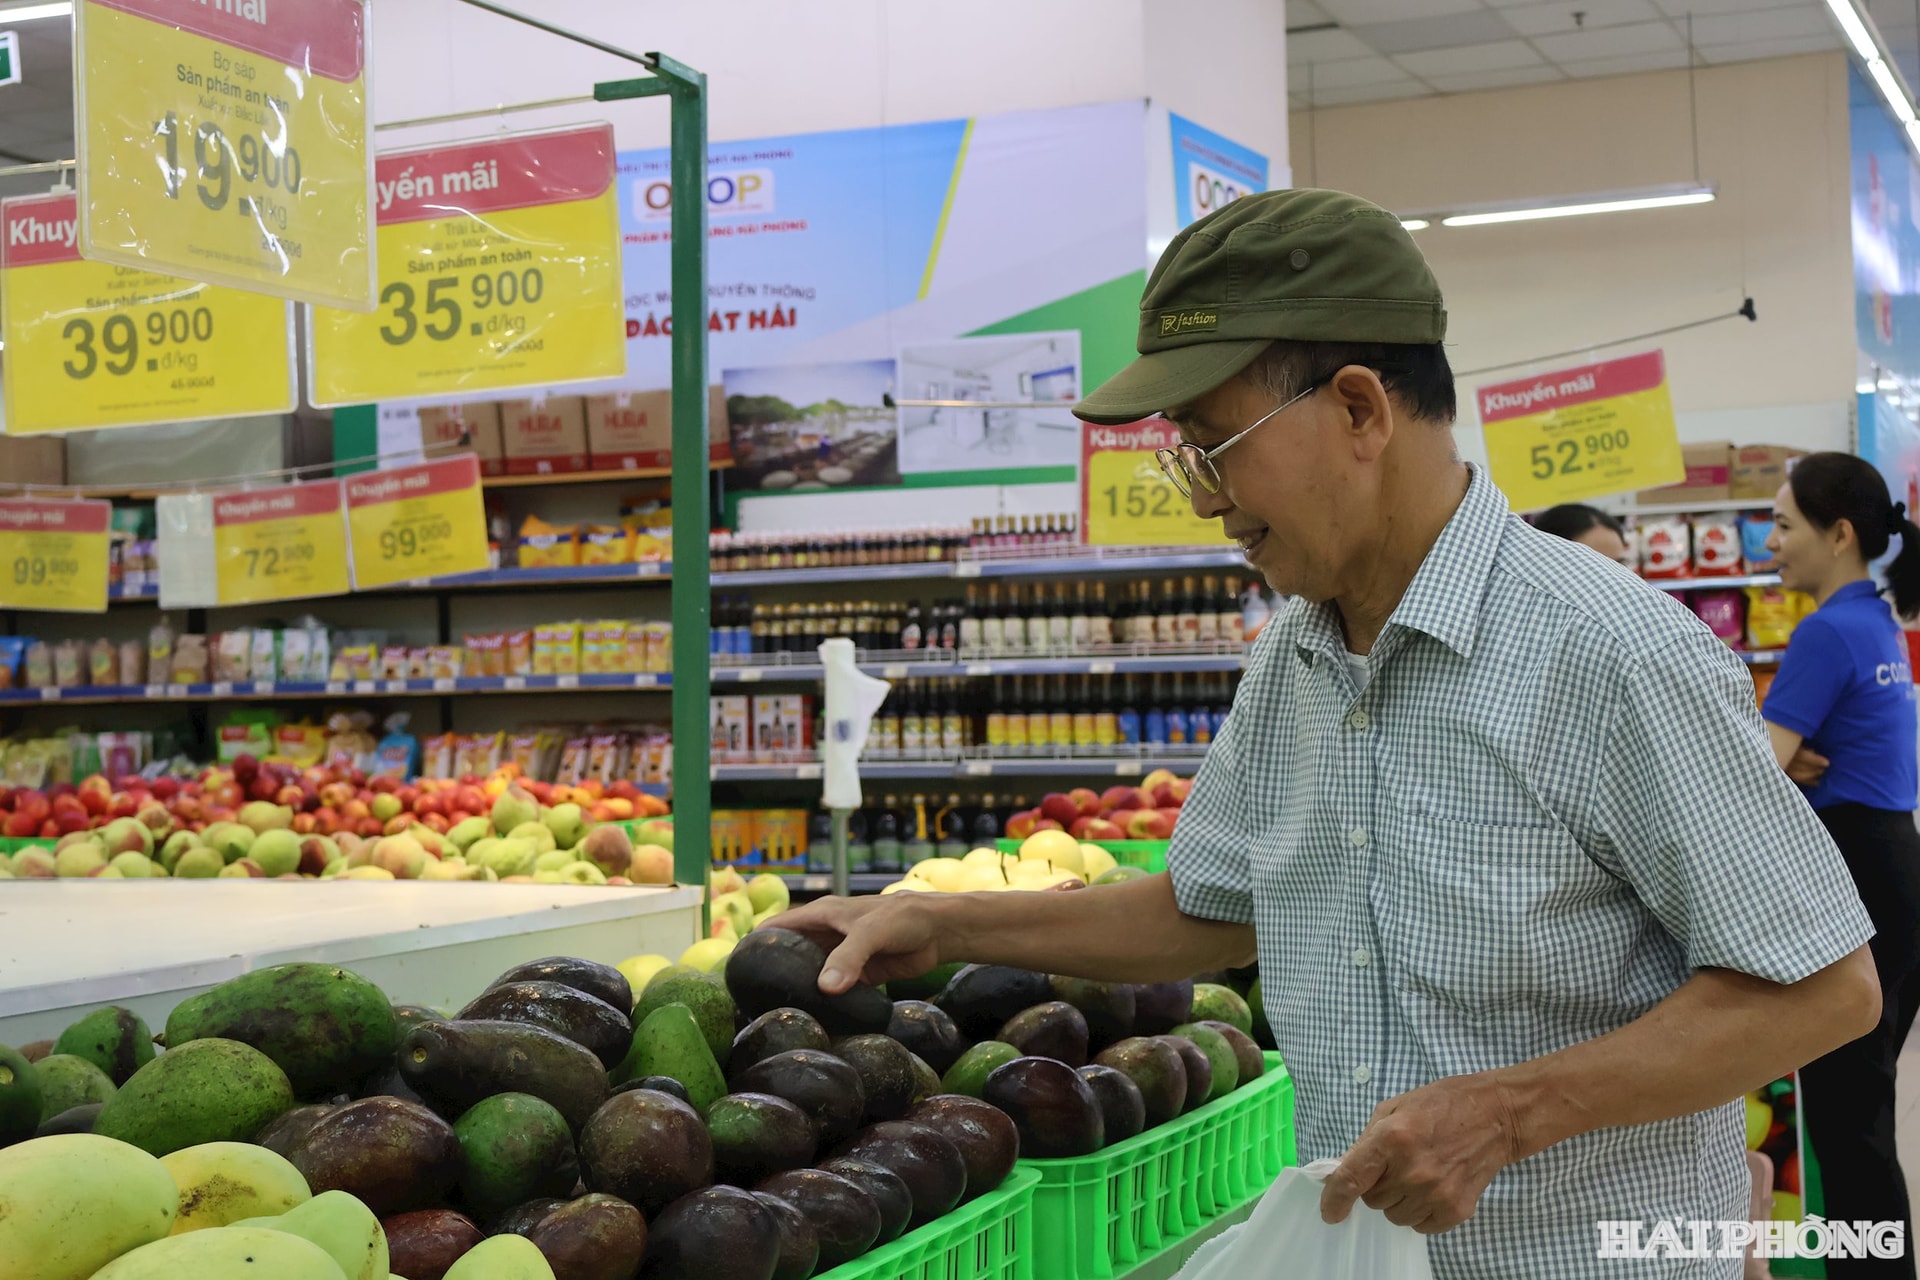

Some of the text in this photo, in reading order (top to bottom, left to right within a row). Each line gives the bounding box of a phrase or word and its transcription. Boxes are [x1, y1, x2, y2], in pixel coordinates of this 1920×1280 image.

[177, 63, 202, 88] Sản
[206, 75, 241, 99] phẩm
[245, 89, 260, 104] an
[376, 160, 498, 210] yến mãi
[645, 174, 762, 210] OOP
[9, 217, 78, 247] Khuy
[408, 248, 532, 273] Sản phẩm an toàn
[1174, 311, 1217, 332] fashion
[1484, 372, 1596, 410] Khuyến mãi
[1089, 425, 1165, 451] Khuyến
[1103, 485, 1191, 518] 152.
